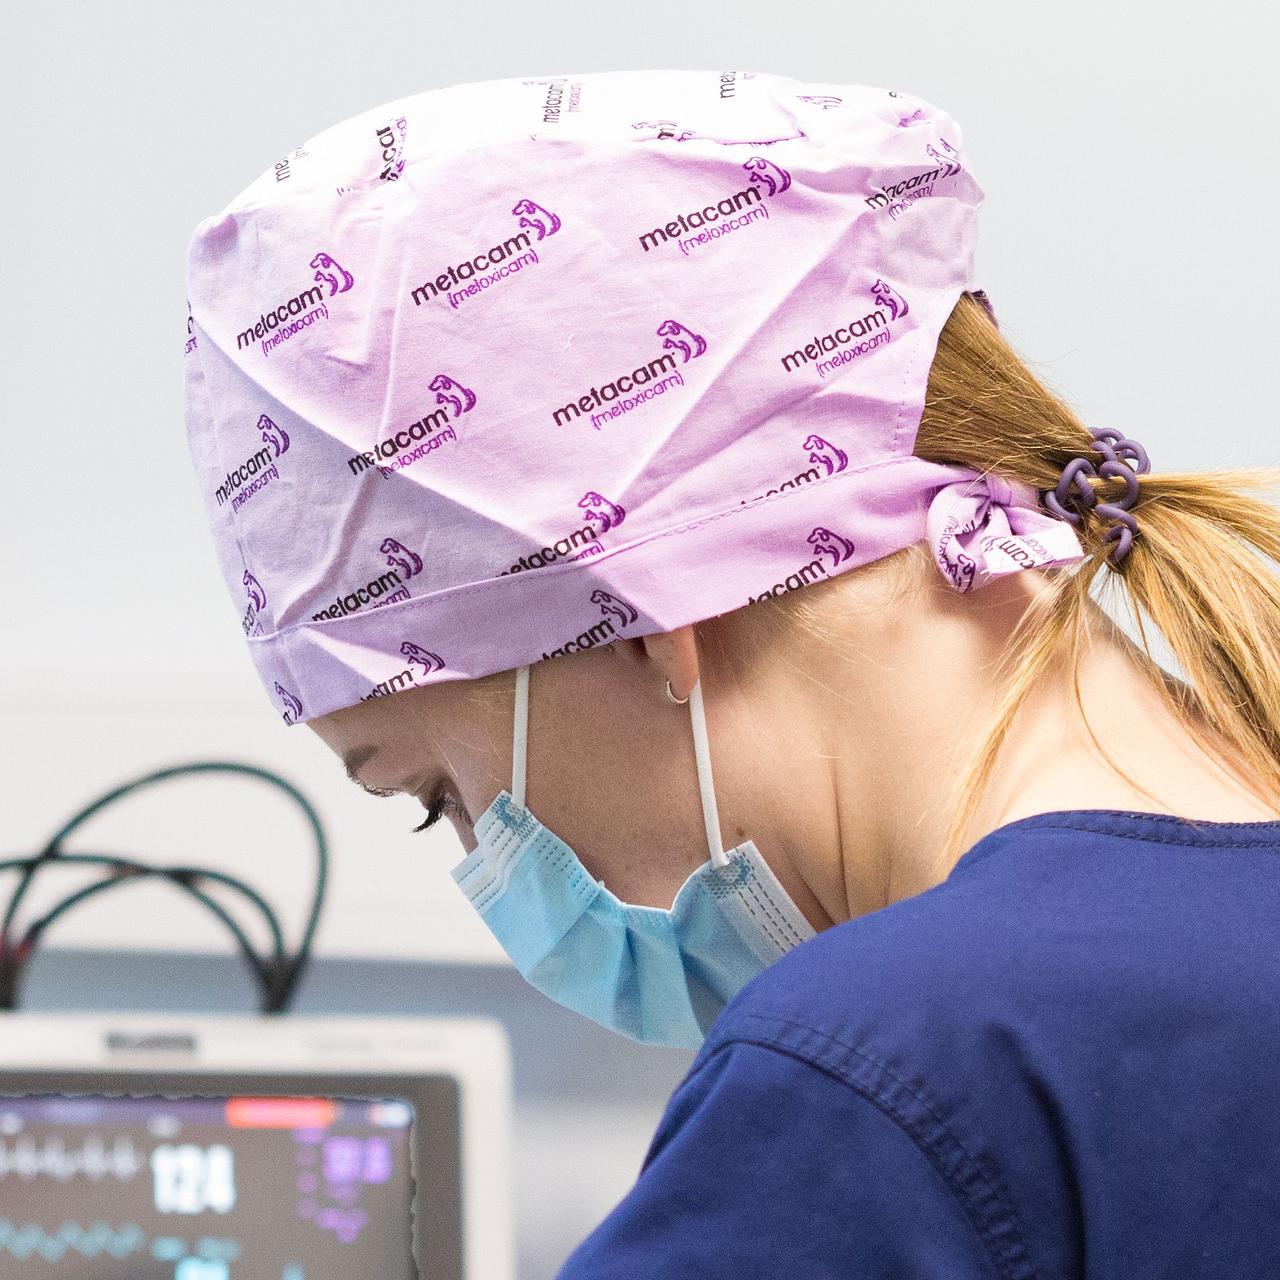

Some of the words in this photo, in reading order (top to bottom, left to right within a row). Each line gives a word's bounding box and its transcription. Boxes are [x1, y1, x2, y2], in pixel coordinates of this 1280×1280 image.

[639, 186, 762, 252] metacam
[678, 203, 769, 256] (meloxicam)
[411, 232, 531, 306] metacam
[447, 248, 539, 309] (meloxicam)
[236, 286, 323, 350] metacam
[261, 302, 329, 357] (meloxicam)
[781, 310, 887, 372] metacam
[815, 326, 891, 379] (meloxicam)
[552, 354, 677, 426] metacam
[591, 370, 685, 431] (meloxicam)
[348, 408, 449, 475] metacam
[215, 447, 273, 507] metacam
